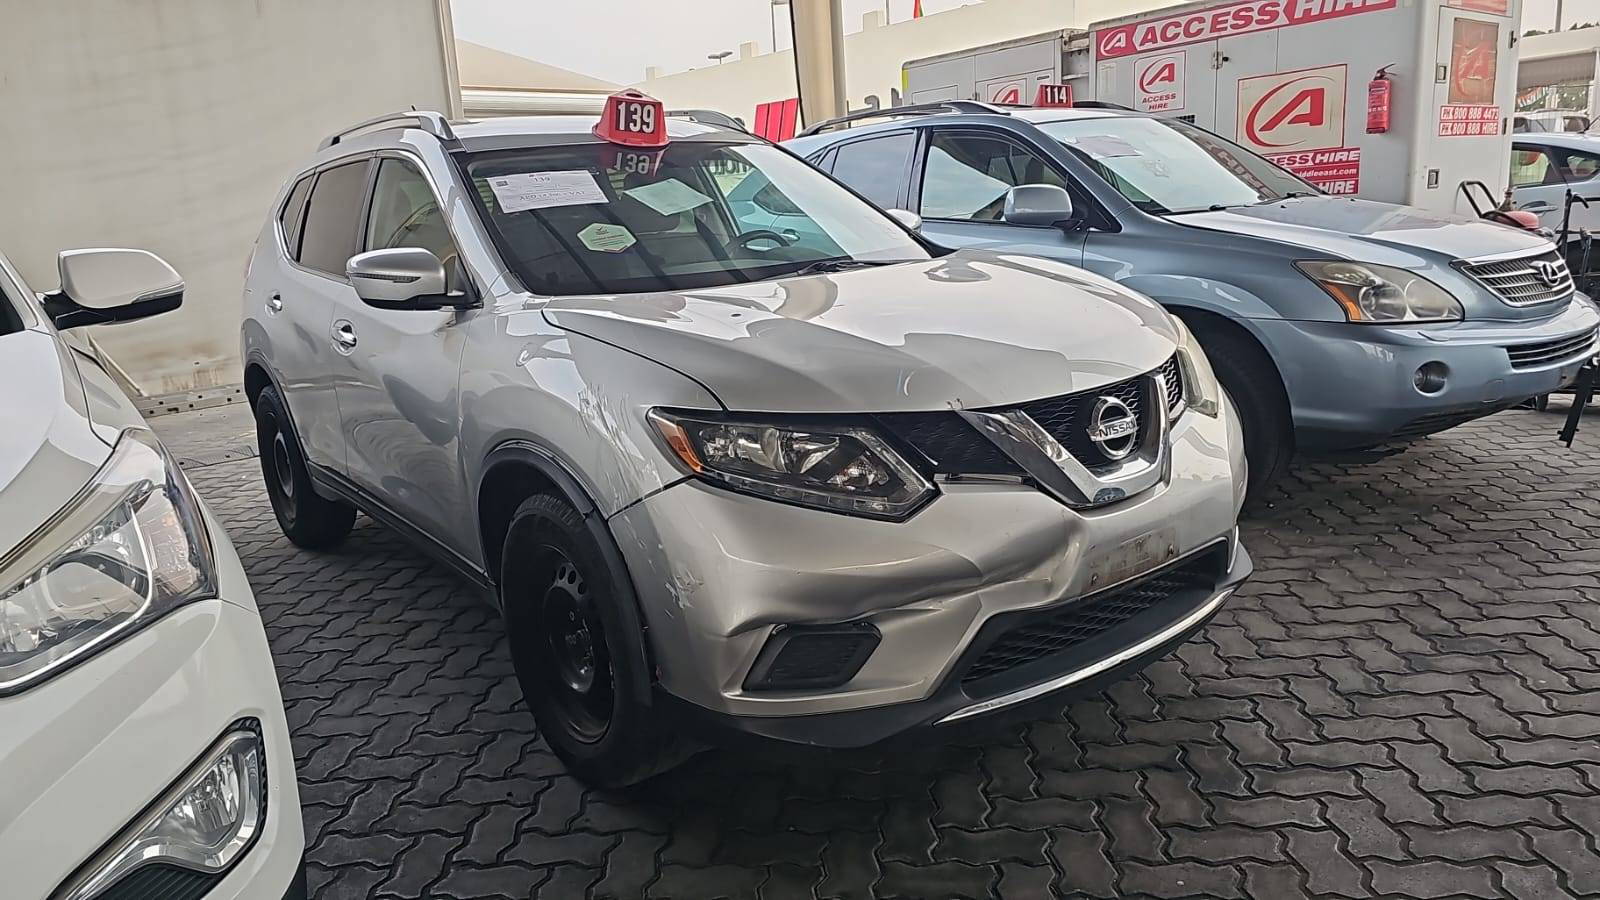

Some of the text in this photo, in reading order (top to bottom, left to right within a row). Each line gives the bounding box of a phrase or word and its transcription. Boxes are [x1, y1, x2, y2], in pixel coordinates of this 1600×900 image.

[1139, 1, 1281, 47] ACCESS
[1046, 86, 1067, 104] 114
[1142, 93, 1176, 103] ACCESS
[618, 102, 655, 133] 139
[1453, 107, 1468, 119] 800
[1468, 107, 1482, 119] 888
[1452, 122, 1466, 135] 800
[1467, 122, 1480, 135] 888
[1314, 151, 1360, 163] HIRE
[1318, 180, 1355, 193] HIRE
[1099, 420, 1136, 437] NISSAN
